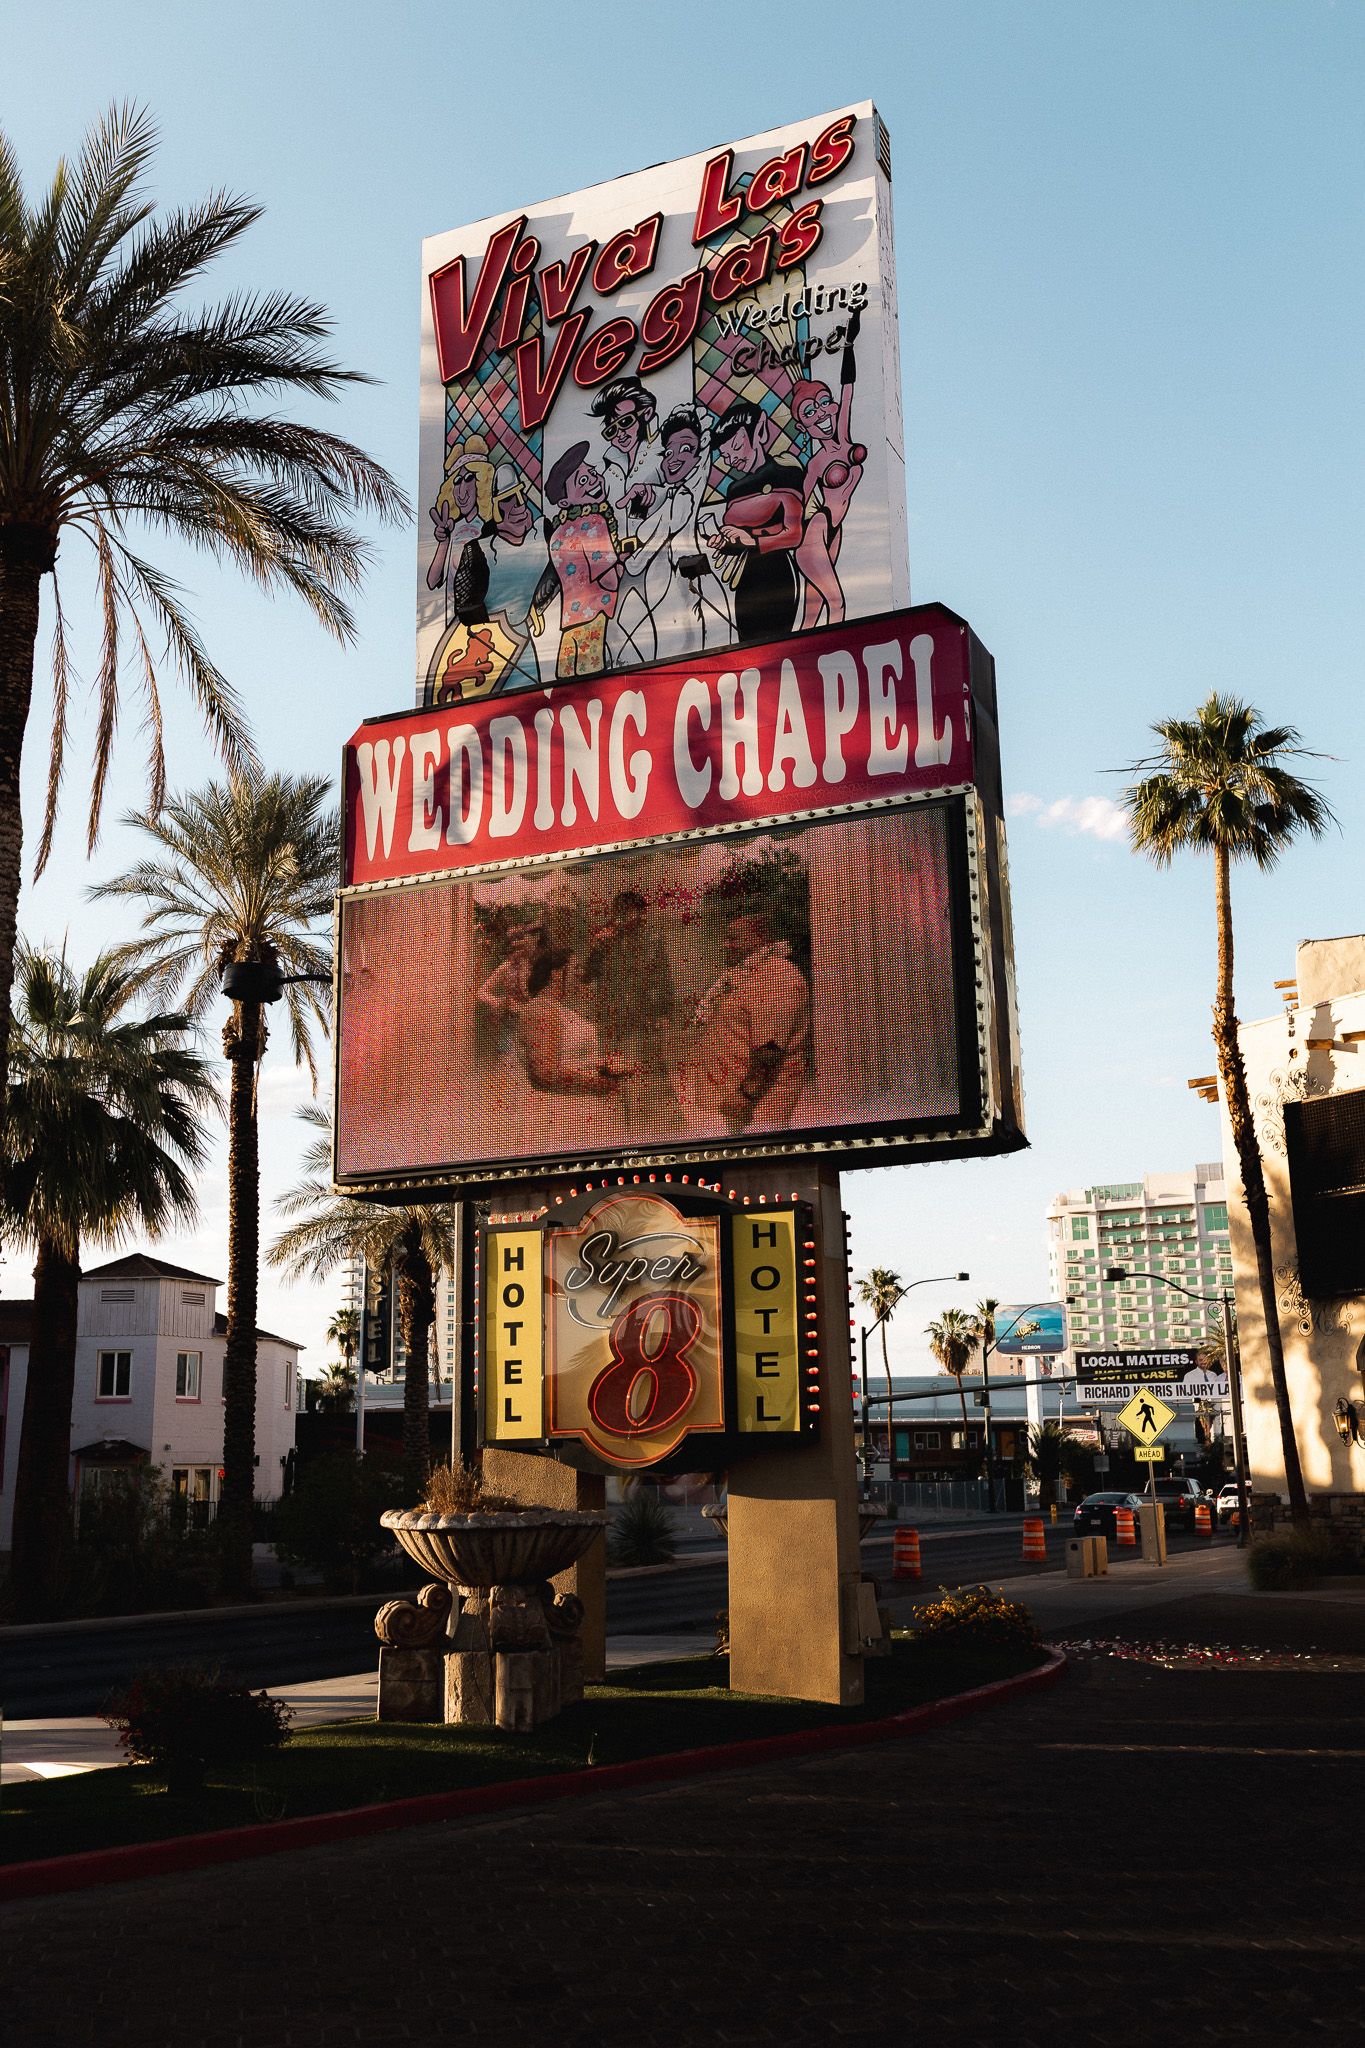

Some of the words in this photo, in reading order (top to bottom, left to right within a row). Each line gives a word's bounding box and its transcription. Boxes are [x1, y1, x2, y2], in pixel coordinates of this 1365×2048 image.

[428, 210, 663, 387] Viva
[691, 113, 858, 248] Las
[714, 280, 869, 339] Wedding
[515, 198, 824, 435] Vegas
[730, 316, 856, 378] Chapel
[356, 688, 653, 863] WEDDING
[673, 633, 953, 809] CHAPEL
[565, 1230, 707, 1319] Super
[751, 1223, 782, 1422] HOTEL
[502, 1247, 525, 1423] HOTEL
[587, 1290, 704, 1440] 8
[1081, 1355, 1125, 1368] LOCAL
[1126, 1353, 1194, 1367] MATTERS.
[1084, 1386, 1130, 1399] RICHARD
[1134, 1385, 1174, 1397] HRRIS
[1176, 1383, 1215, 1397] INJURY
[1218, 1383, 1229, 1396] LA
[1138, 1450, 1161, 1459] AHEAD
